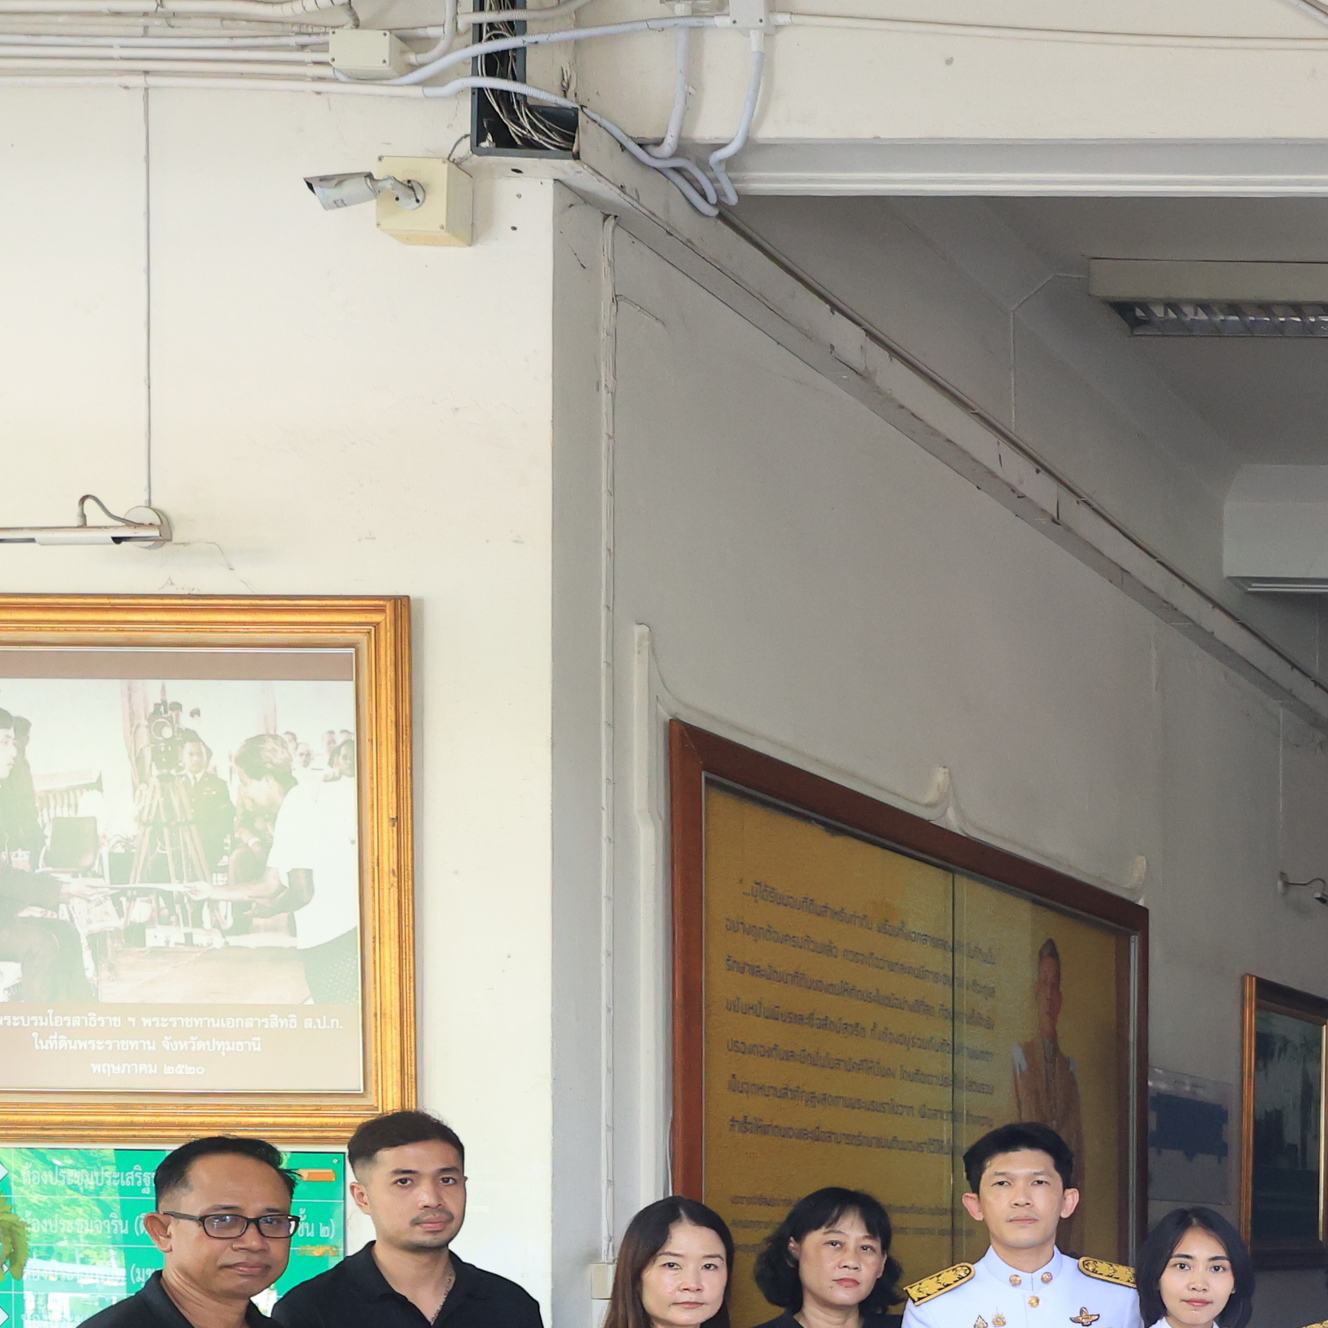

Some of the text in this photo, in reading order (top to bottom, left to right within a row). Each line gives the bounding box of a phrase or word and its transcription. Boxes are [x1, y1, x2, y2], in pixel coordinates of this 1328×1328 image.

[141, 1013, 297, 1029] พระราชทานเอกสารสิทธิ
[303, 1015, 343, 1030] ส.ป.ก.
[32, 1032, 262, 1056] ในที่ดินพระราชทาน จังหวัดปทุมธานี
[90, 1062, 206, 1077] พฤษภาคม ๒๕๒๐
